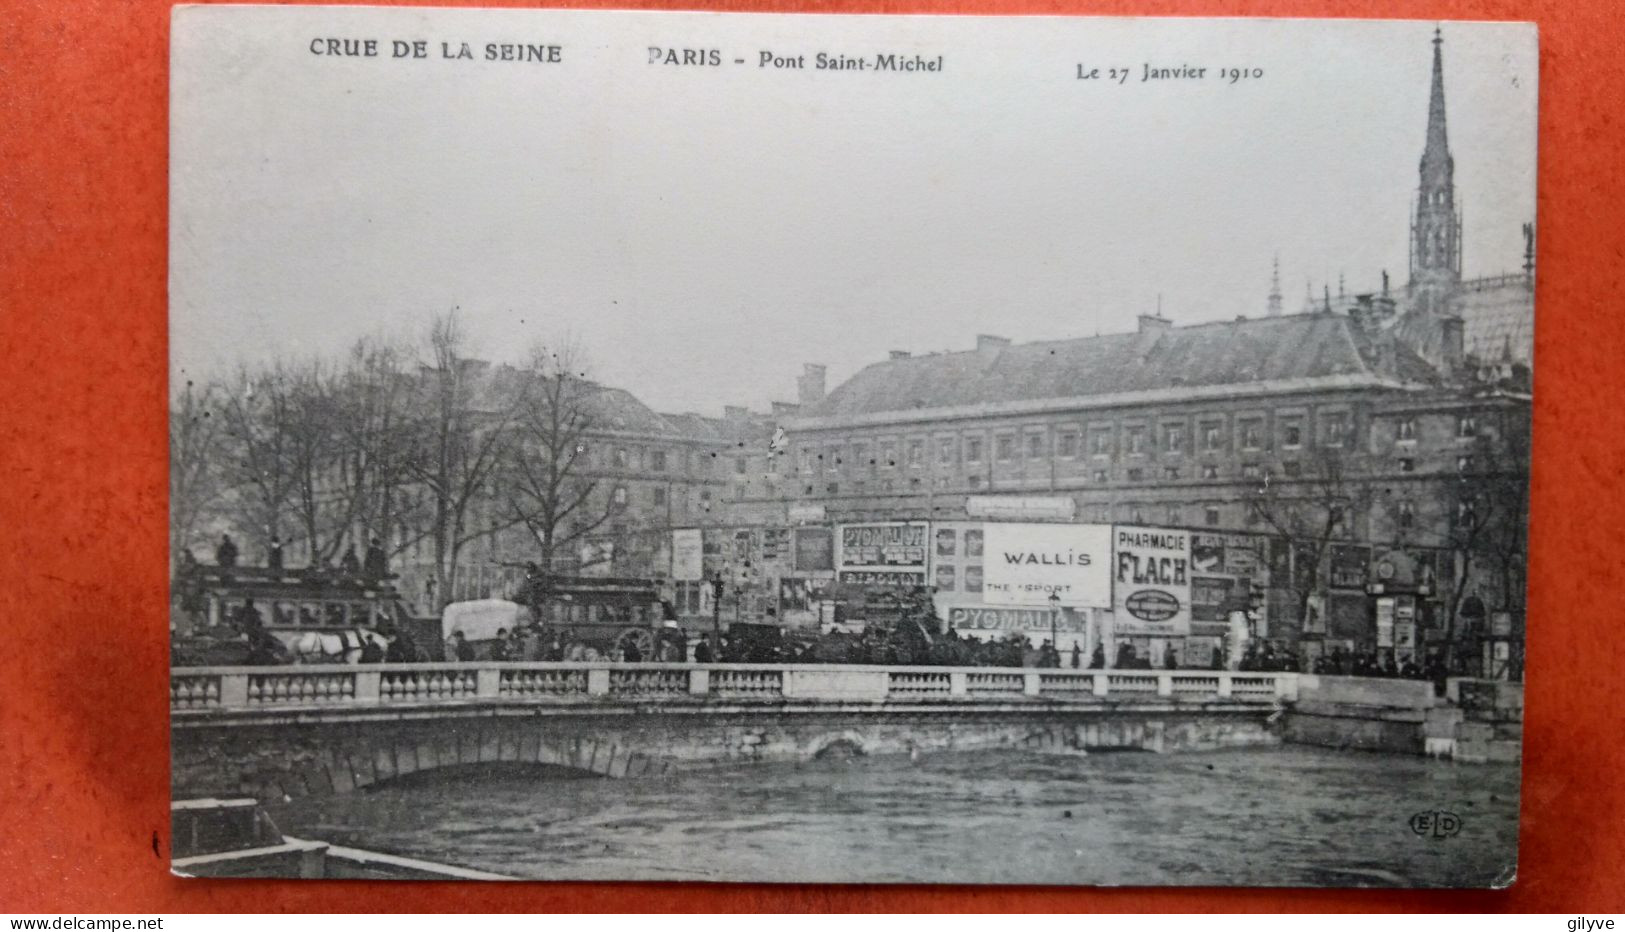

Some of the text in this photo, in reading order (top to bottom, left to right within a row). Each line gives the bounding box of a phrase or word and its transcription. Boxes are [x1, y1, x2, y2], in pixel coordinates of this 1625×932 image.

[1119, 532, 1185, 550] PHARMACIE
[1117, 551, 1187, 586] FLACH
[987, 583, 1010, 592] THE
